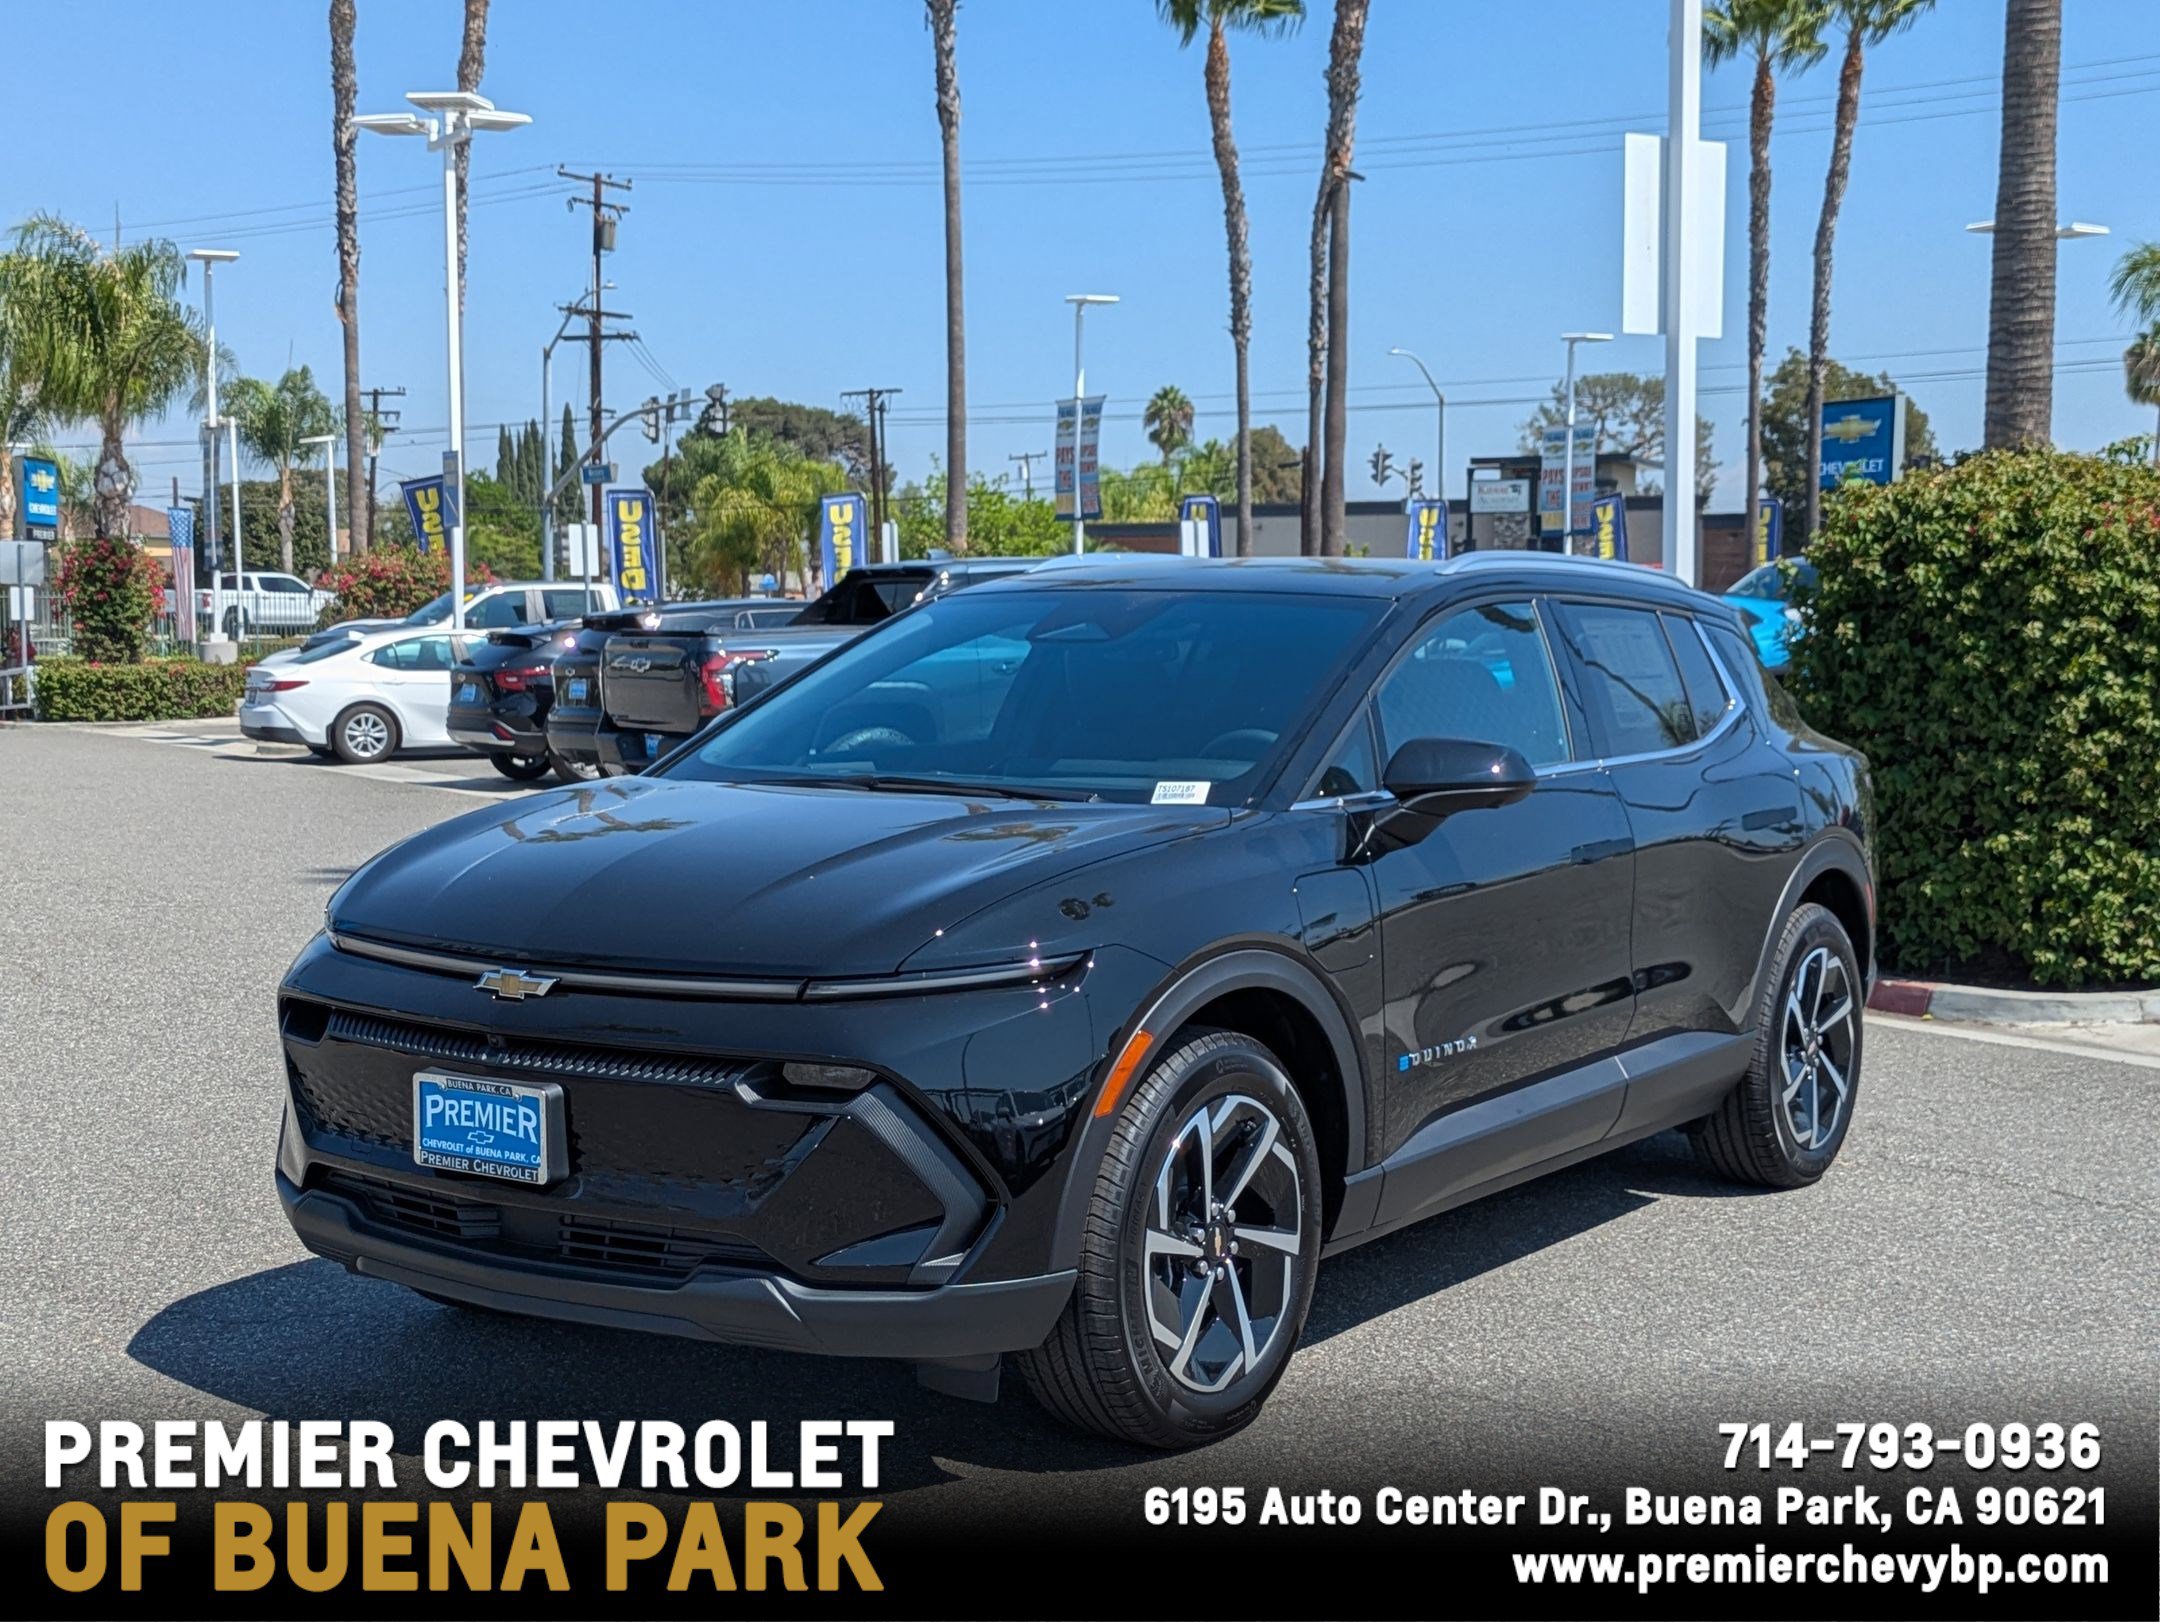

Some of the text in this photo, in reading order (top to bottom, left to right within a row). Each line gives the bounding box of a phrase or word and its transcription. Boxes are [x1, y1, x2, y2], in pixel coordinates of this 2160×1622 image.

[1819, 459, 1884, 476] CHEVLET
[447, 1079, 474, 1091] BUENA
[425, 1094, 538, 1145] PREMIER
[422, 1138, 464, 1152] CHEVROLET
[465, 1144, 474, 1154] of
[475, 1146, 502, 1159] BUENA
[420, 1150, 538, 1182] PREMIER CHEVROLET
